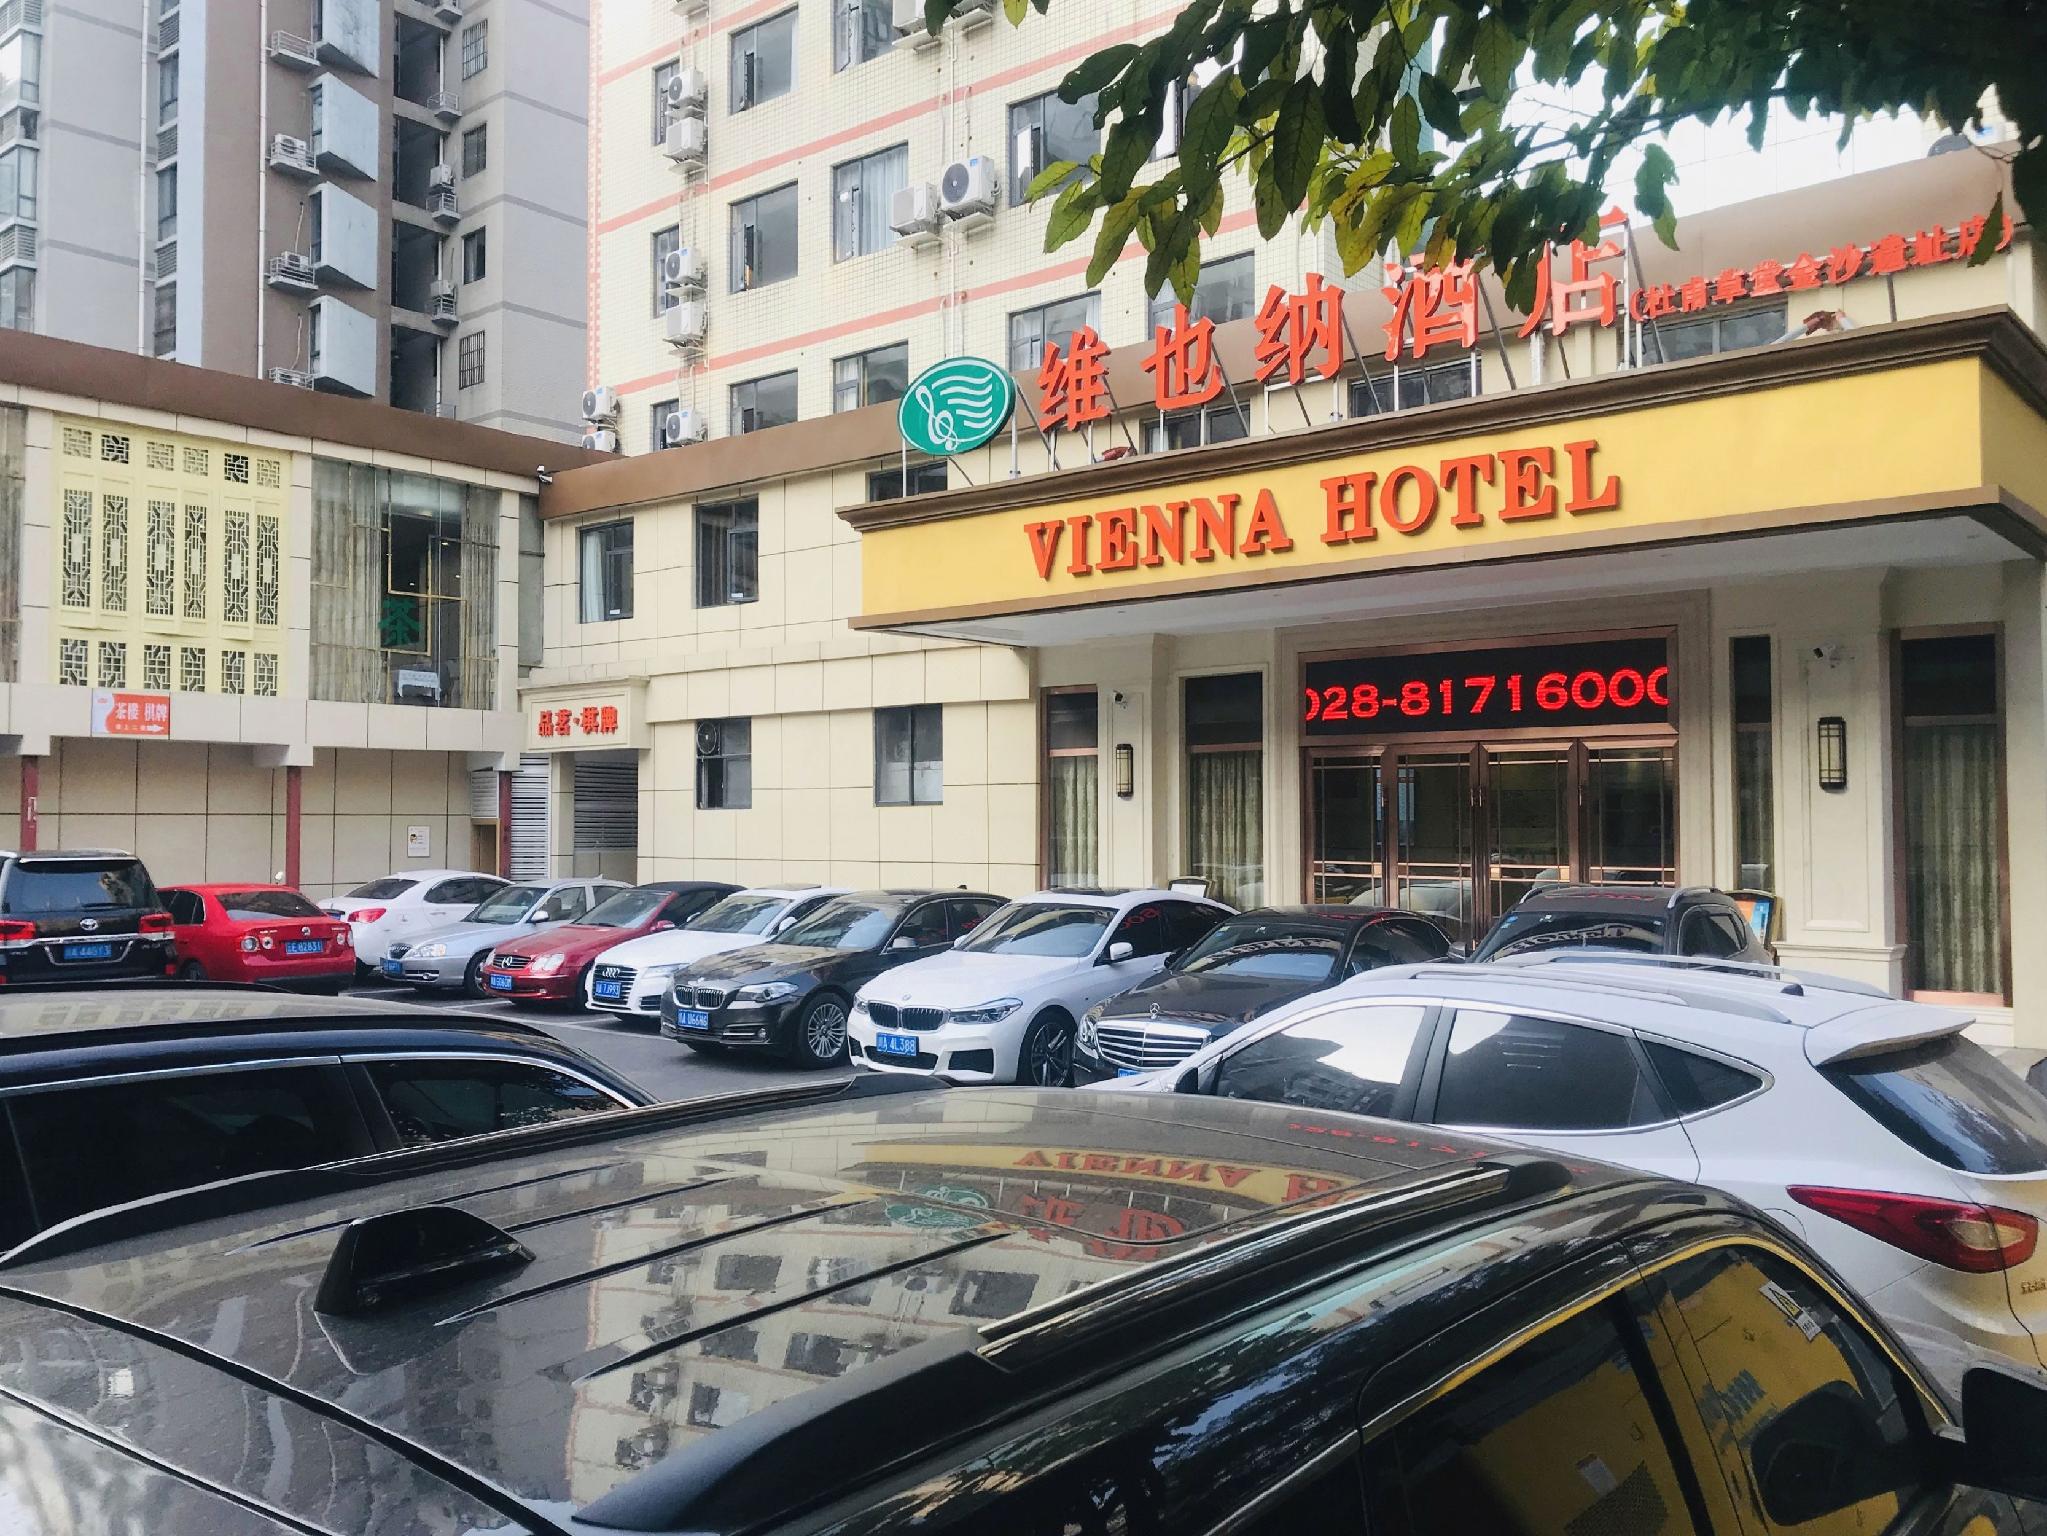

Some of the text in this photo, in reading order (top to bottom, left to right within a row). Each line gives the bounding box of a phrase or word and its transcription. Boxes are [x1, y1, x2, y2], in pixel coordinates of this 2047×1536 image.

[1037, 205, 1630, 432] 维也纳酒店
[1025, 440, 1621, 578] VIENNA HOTEL
